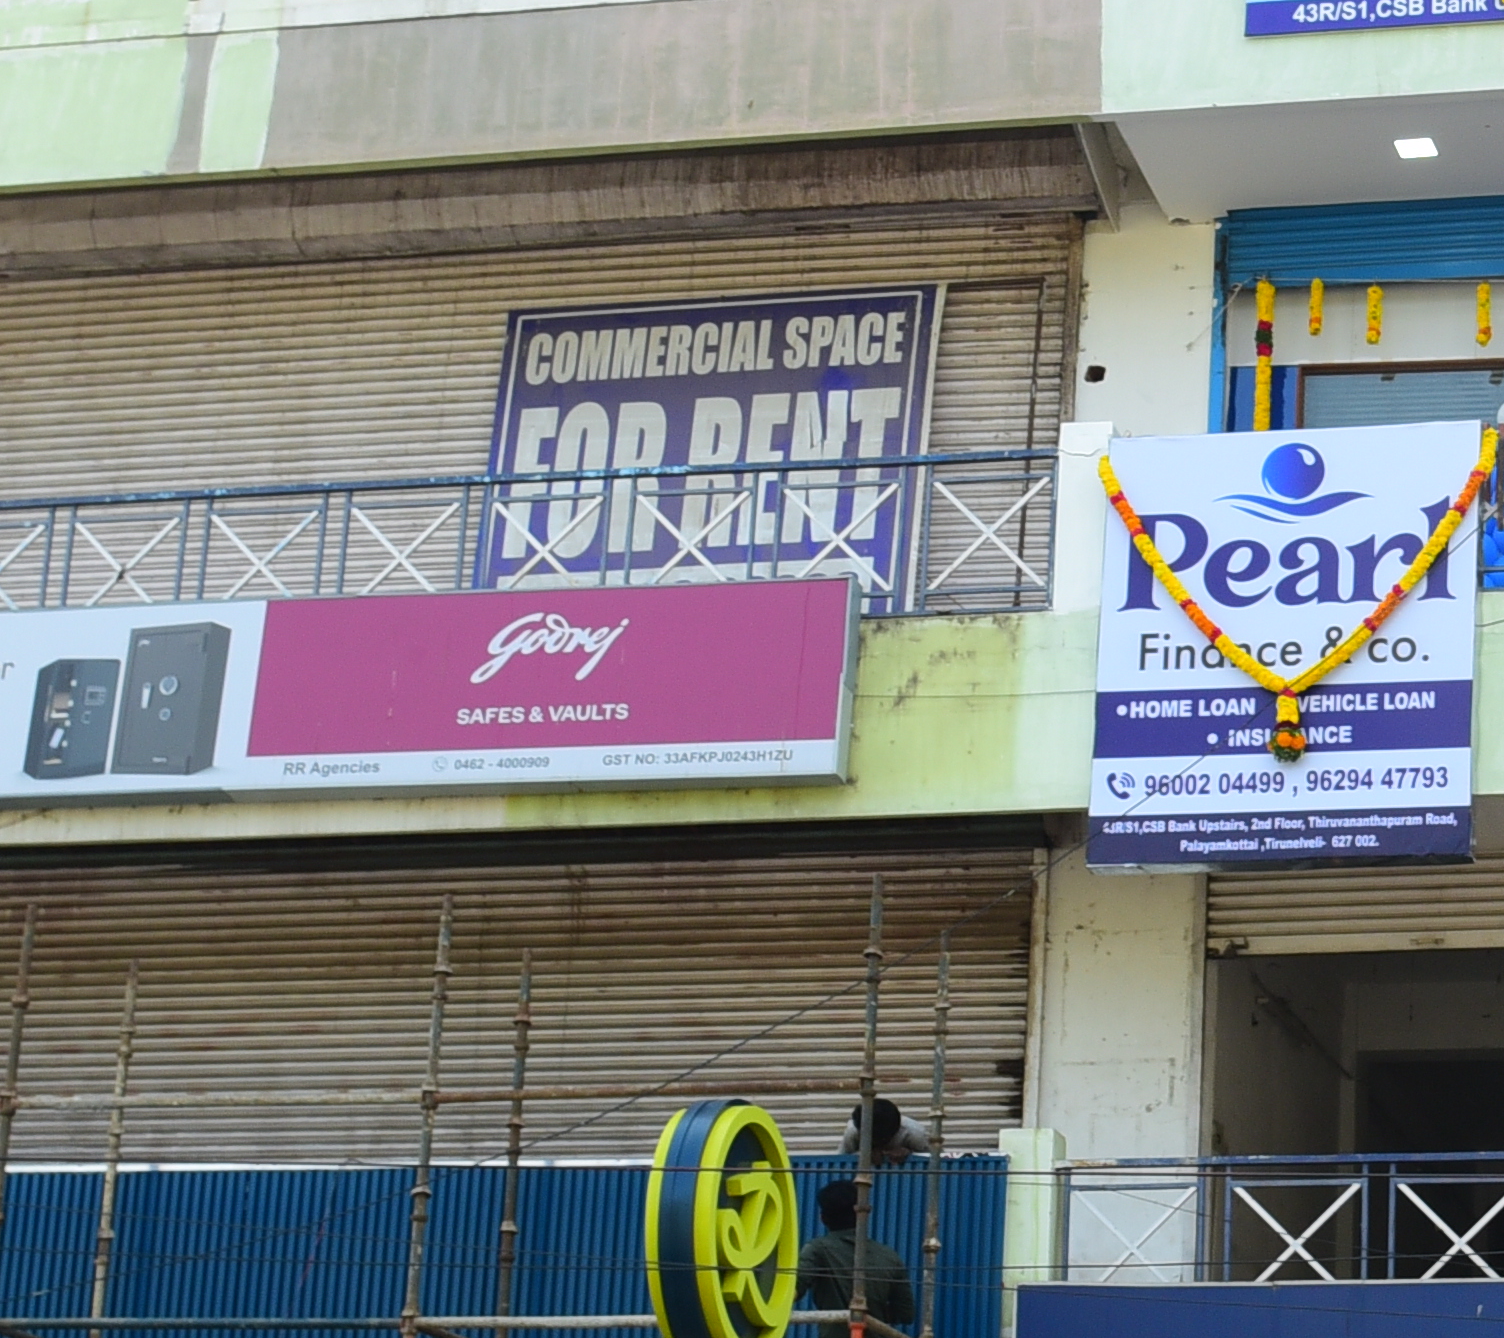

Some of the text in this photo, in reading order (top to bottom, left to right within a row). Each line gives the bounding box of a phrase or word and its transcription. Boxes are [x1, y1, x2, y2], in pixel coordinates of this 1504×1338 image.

[525, 311, 907, 386] COMMERCIAL SPACE
[501, 387, 902, 559] FOR RENT
[1117, 495, 1456, 612] Pearl
[469, 611, 630, 685] Godrej
[1368, 636, 1430, 663] co.
[456, 703, 630, 727] SAFES & VAULTS
[1129, 691, 1436, 719] HOME LOAN VEHICLE LOAN
[283, 759, 381, 779] RR Agencies
[453, 755, 551, 771] 0462 4000909
[602, 754, 631, 766] GST
[635, 752, 660, 765] NO:
[1145, 766, 1449, 796] 96002 04499 96294 47793
[1168, 819, 1196, 832] Bank
[1199, 817, 1248, 834] Upstairs,
[1251, 816, 1272, 830] 2nd
[1274, 815, 1306, 831] Floor,
[1425, 812, 1458, 828] Road,
[1331, 835, 1353, 848] 627
[1355, 834, 1380, 848] 002.
